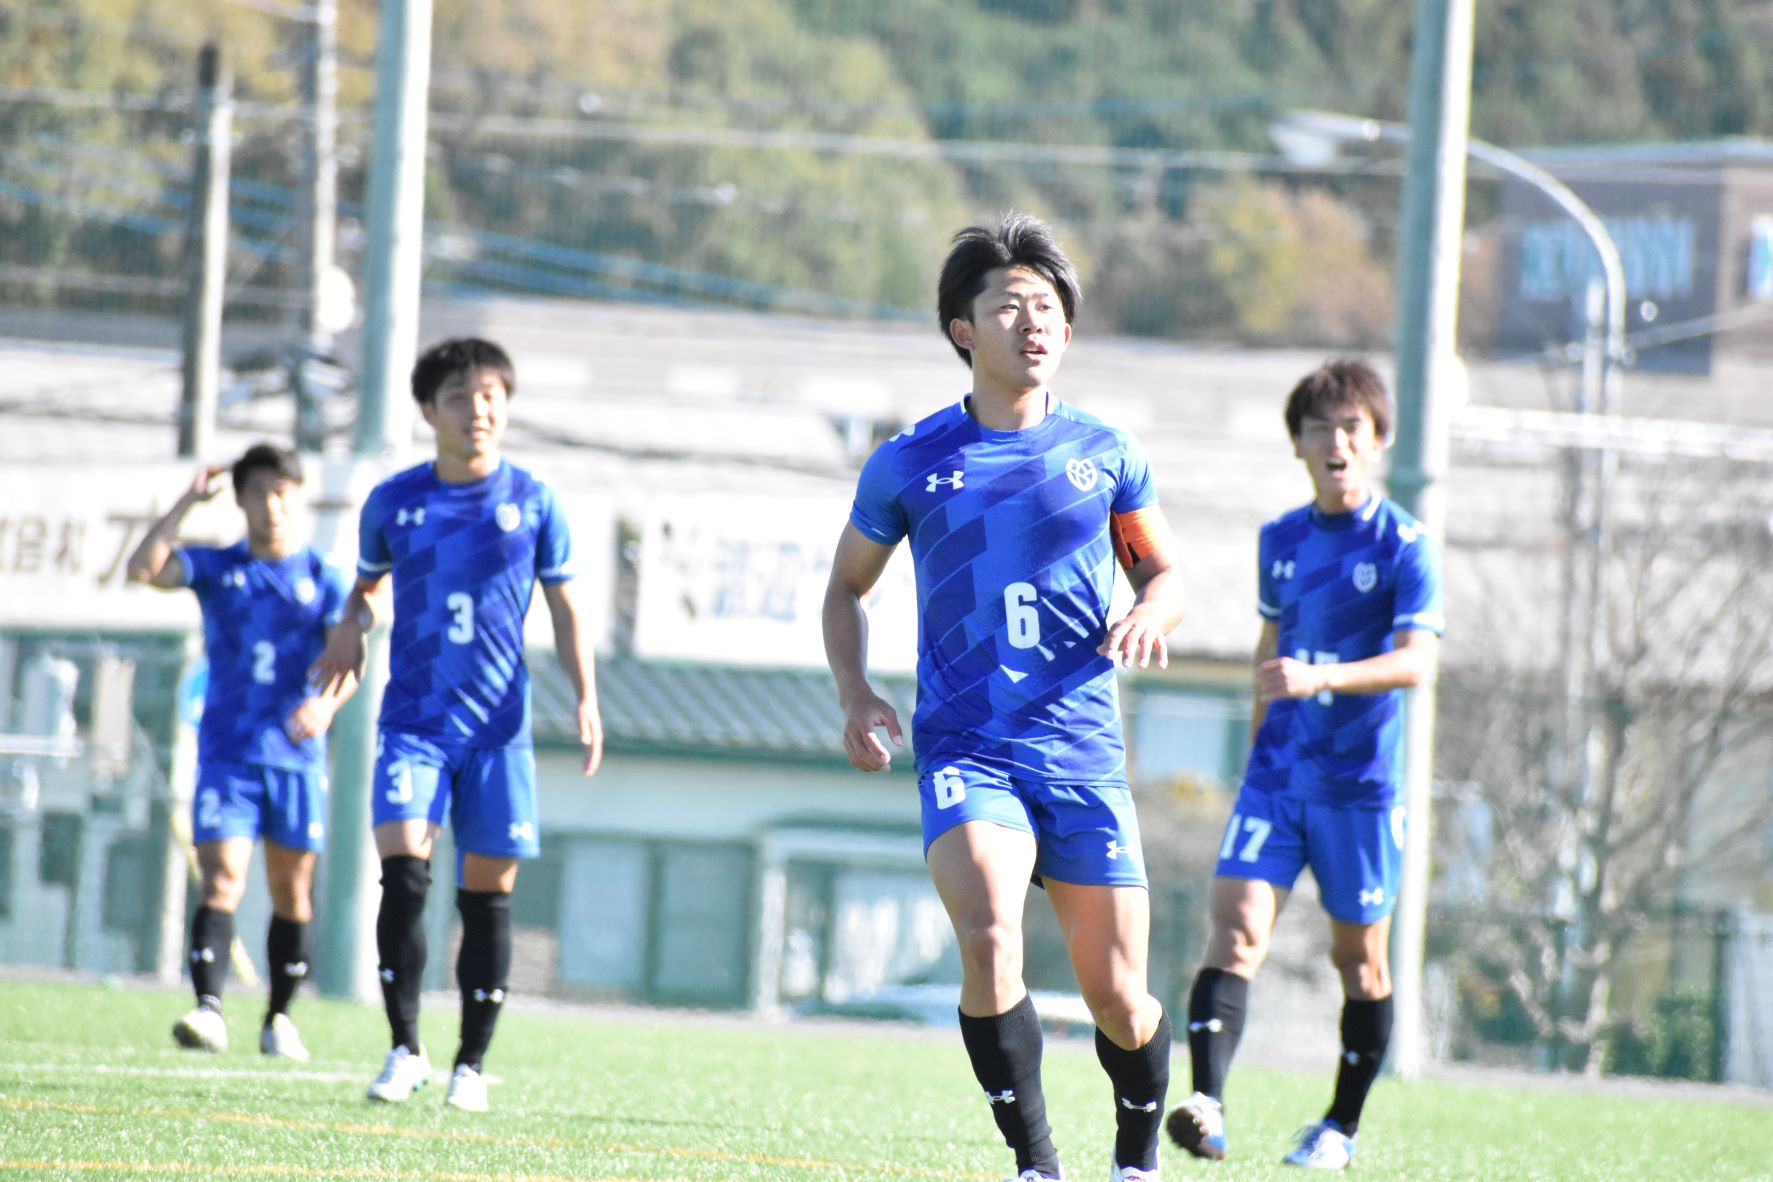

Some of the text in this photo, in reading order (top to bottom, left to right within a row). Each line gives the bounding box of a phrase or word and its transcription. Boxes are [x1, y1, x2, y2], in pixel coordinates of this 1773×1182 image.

[447, 592, 475, 644] 3
[1003, 581, 1040, 650] 6
[253, 641, 276, 685] 2
[386, 760, 413, 805] 3
[933, 765, 965, 810] 6
[200, 787, 222, 828] 2
[1219, 813, 1272, 864] 17
